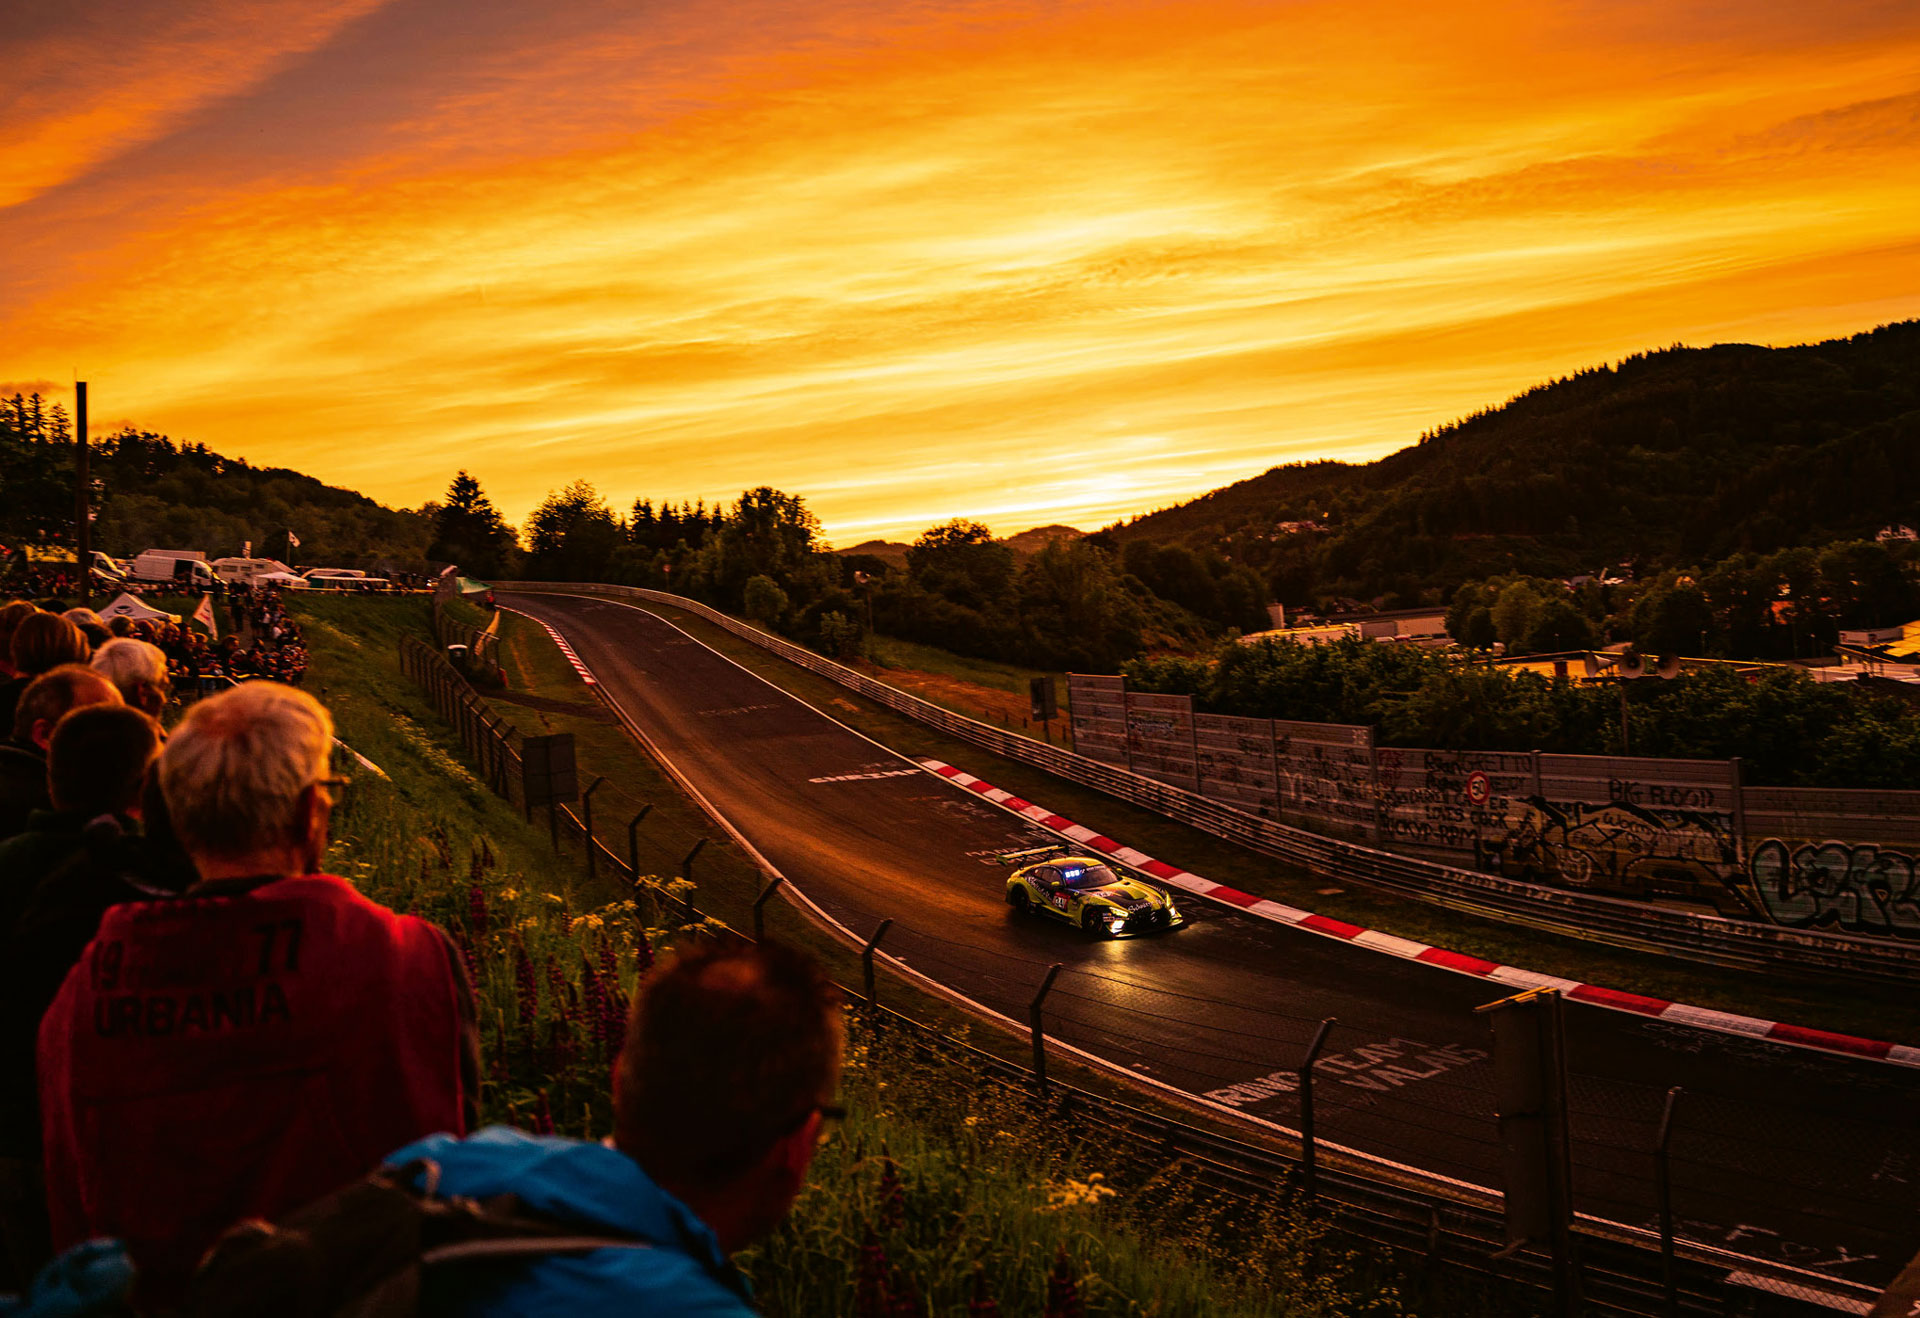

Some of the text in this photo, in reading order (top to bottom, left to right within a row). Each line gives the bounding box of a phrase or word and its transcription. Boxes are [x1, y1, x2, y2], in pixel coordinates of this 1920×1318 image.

[1609, 779, 1643, 804] BIG
[252, 918, 304, 975] 77
[95, 983, 292, 1038] URBANIA
[1201, 1070, 1318, 1107] RING
[1338, 1043, 1489, 1092] VALAIS
